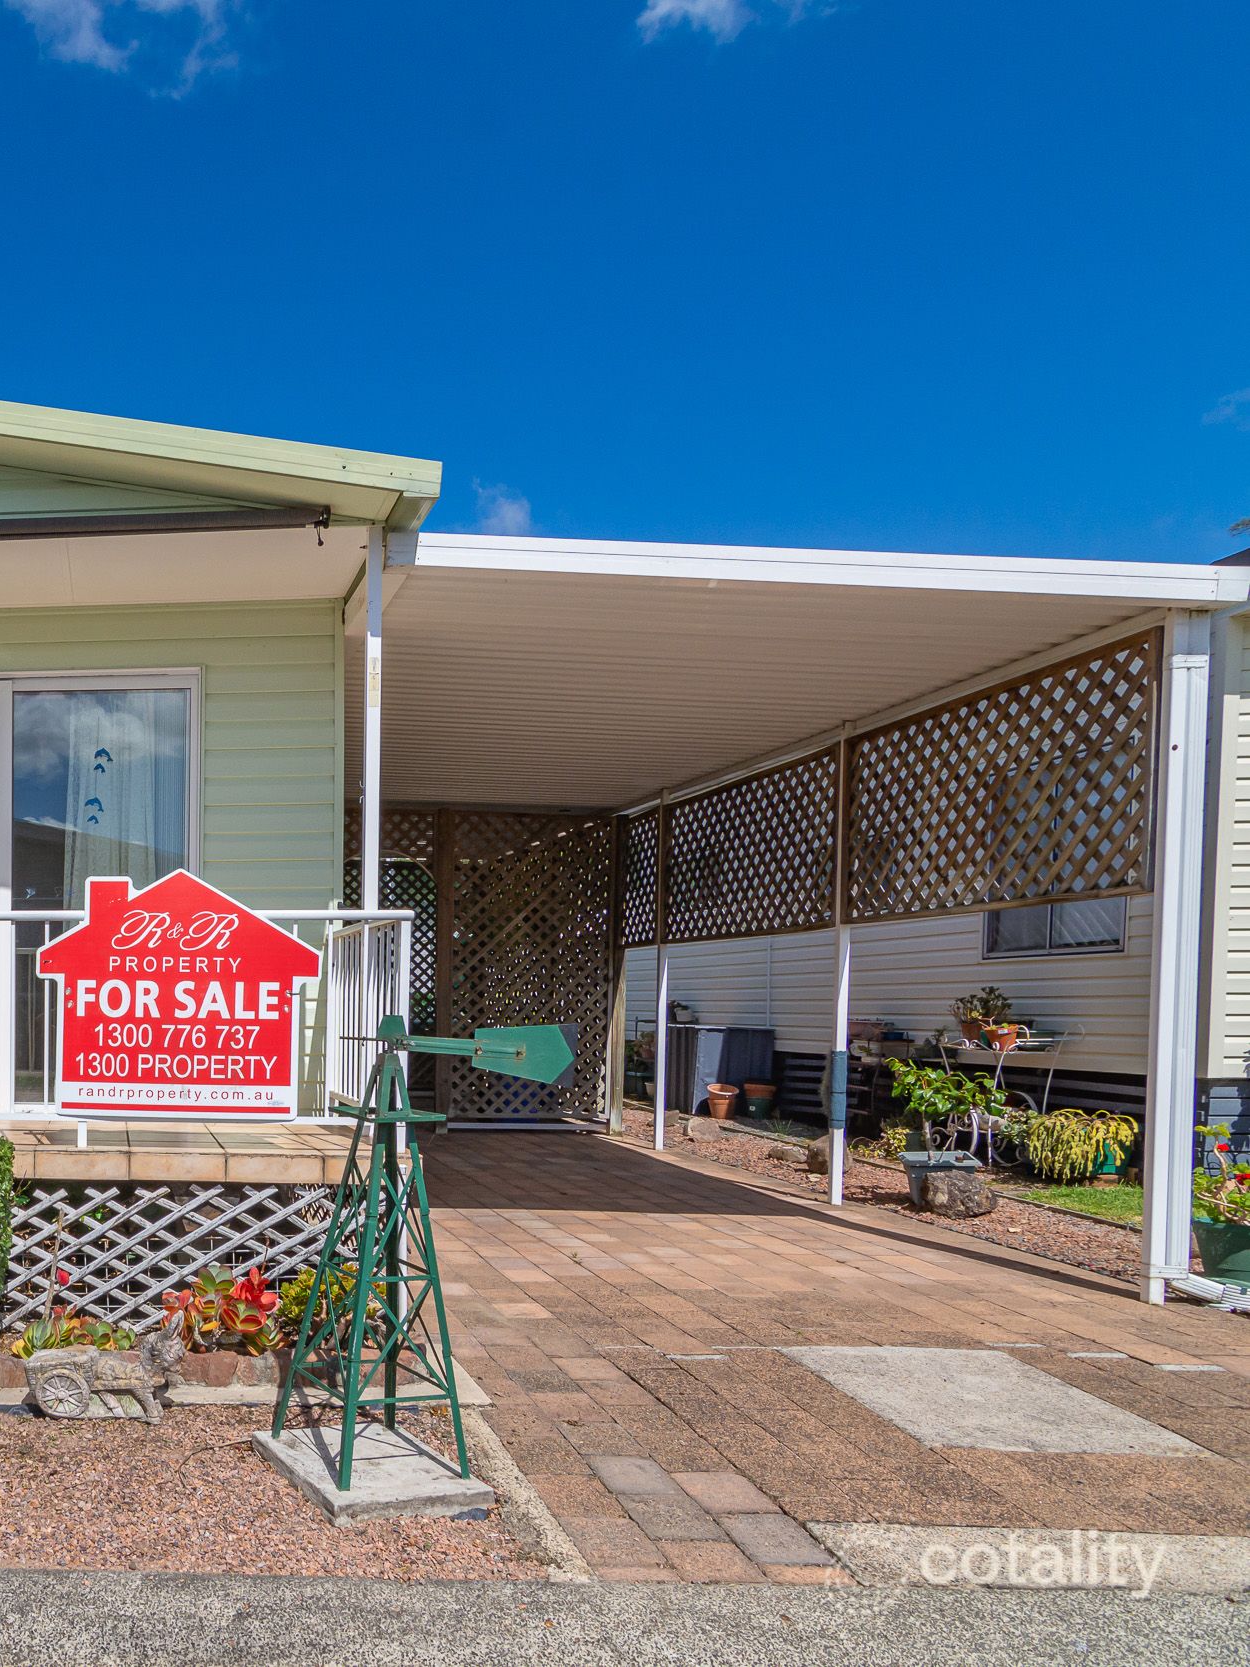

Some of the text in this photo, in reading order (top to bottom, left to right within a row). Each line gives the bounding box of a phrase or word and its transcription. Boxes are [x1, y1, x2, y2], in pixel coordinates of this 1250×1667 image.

[110, 956, 242, 972] PROPERTY
[76, 980, 280, 1020] FOR SALE
[94, 1024, 260, 1049] 1300 776 737
[76, 1052, 278, 1079] 1300 PROPERTY
[78, 1086, 274, 1101] randrproperty.com.au
